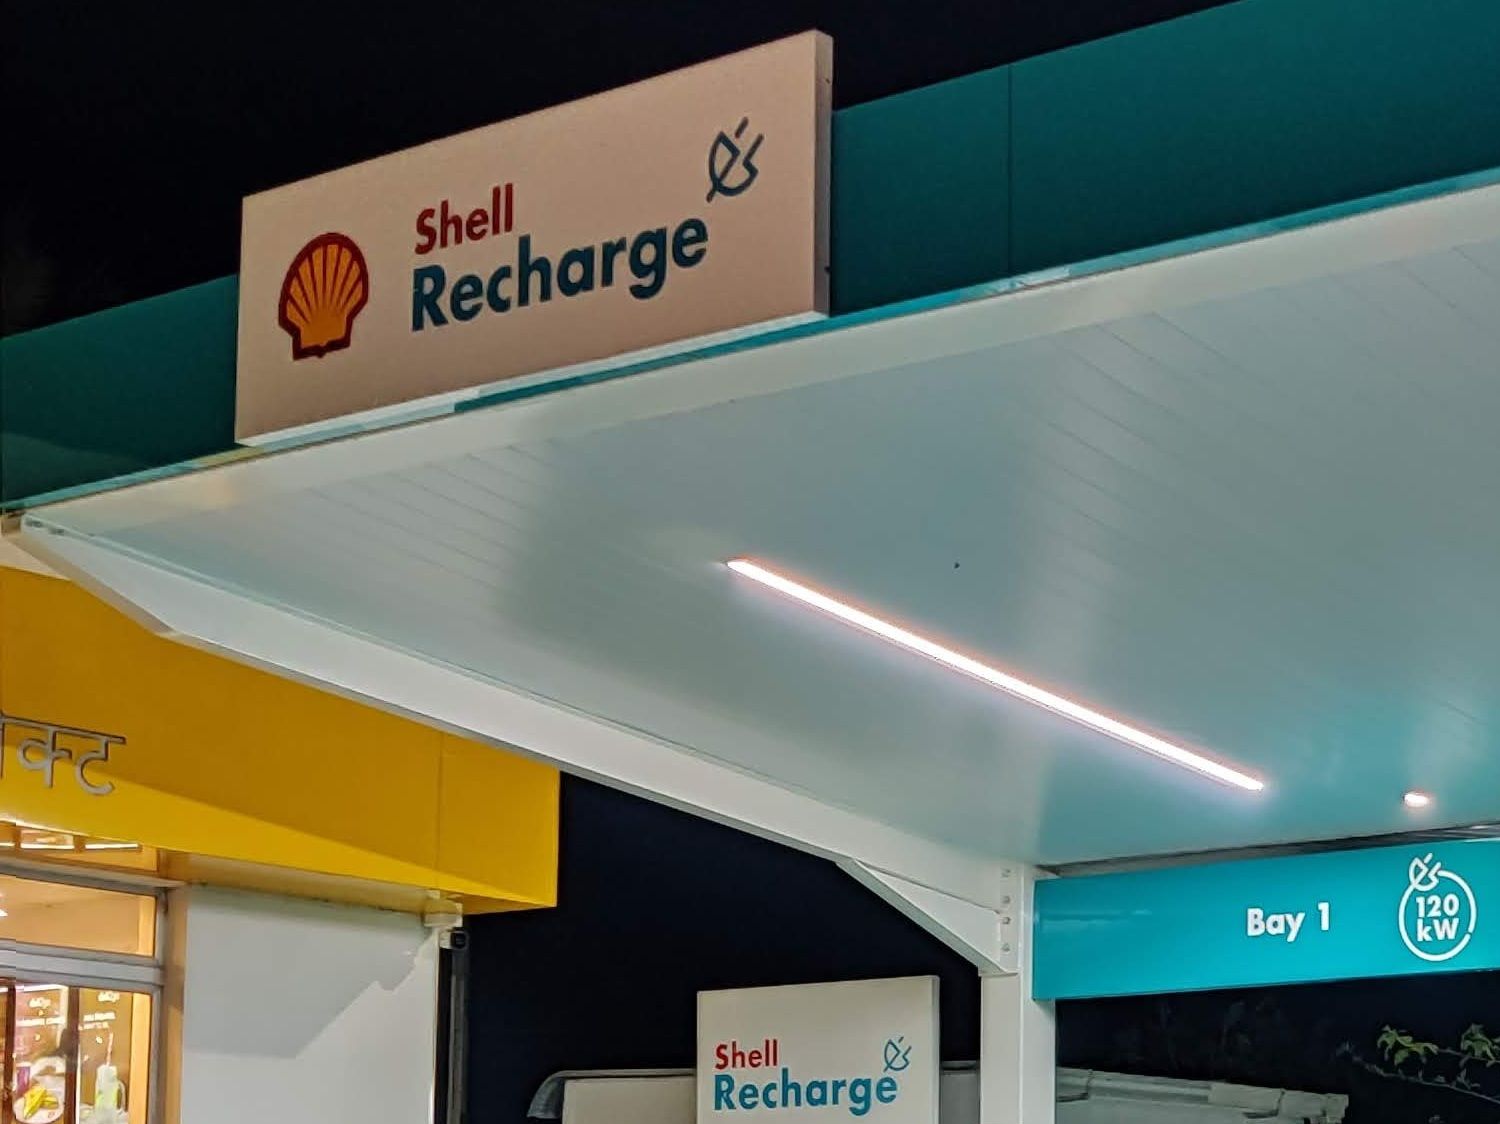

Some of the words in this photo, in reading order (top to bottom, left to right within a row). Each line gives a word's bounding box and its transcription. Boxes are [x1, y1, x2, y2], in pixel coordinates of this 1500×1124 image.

[414, 182, 514, 255] Shell
[411, 217, 709, 332] Recharge
[0, 709, 127, 795] क्ट
[1247, 907, 1305, 942] Bay
[1317, 902, 1330, 931] 1
[1415, 893, 1460, 919] 120
[1417, 917, 1460, 942] kW
[714, 1039, 779, 1070] Shell
[714, 1068, 898, 1116] Recharge
